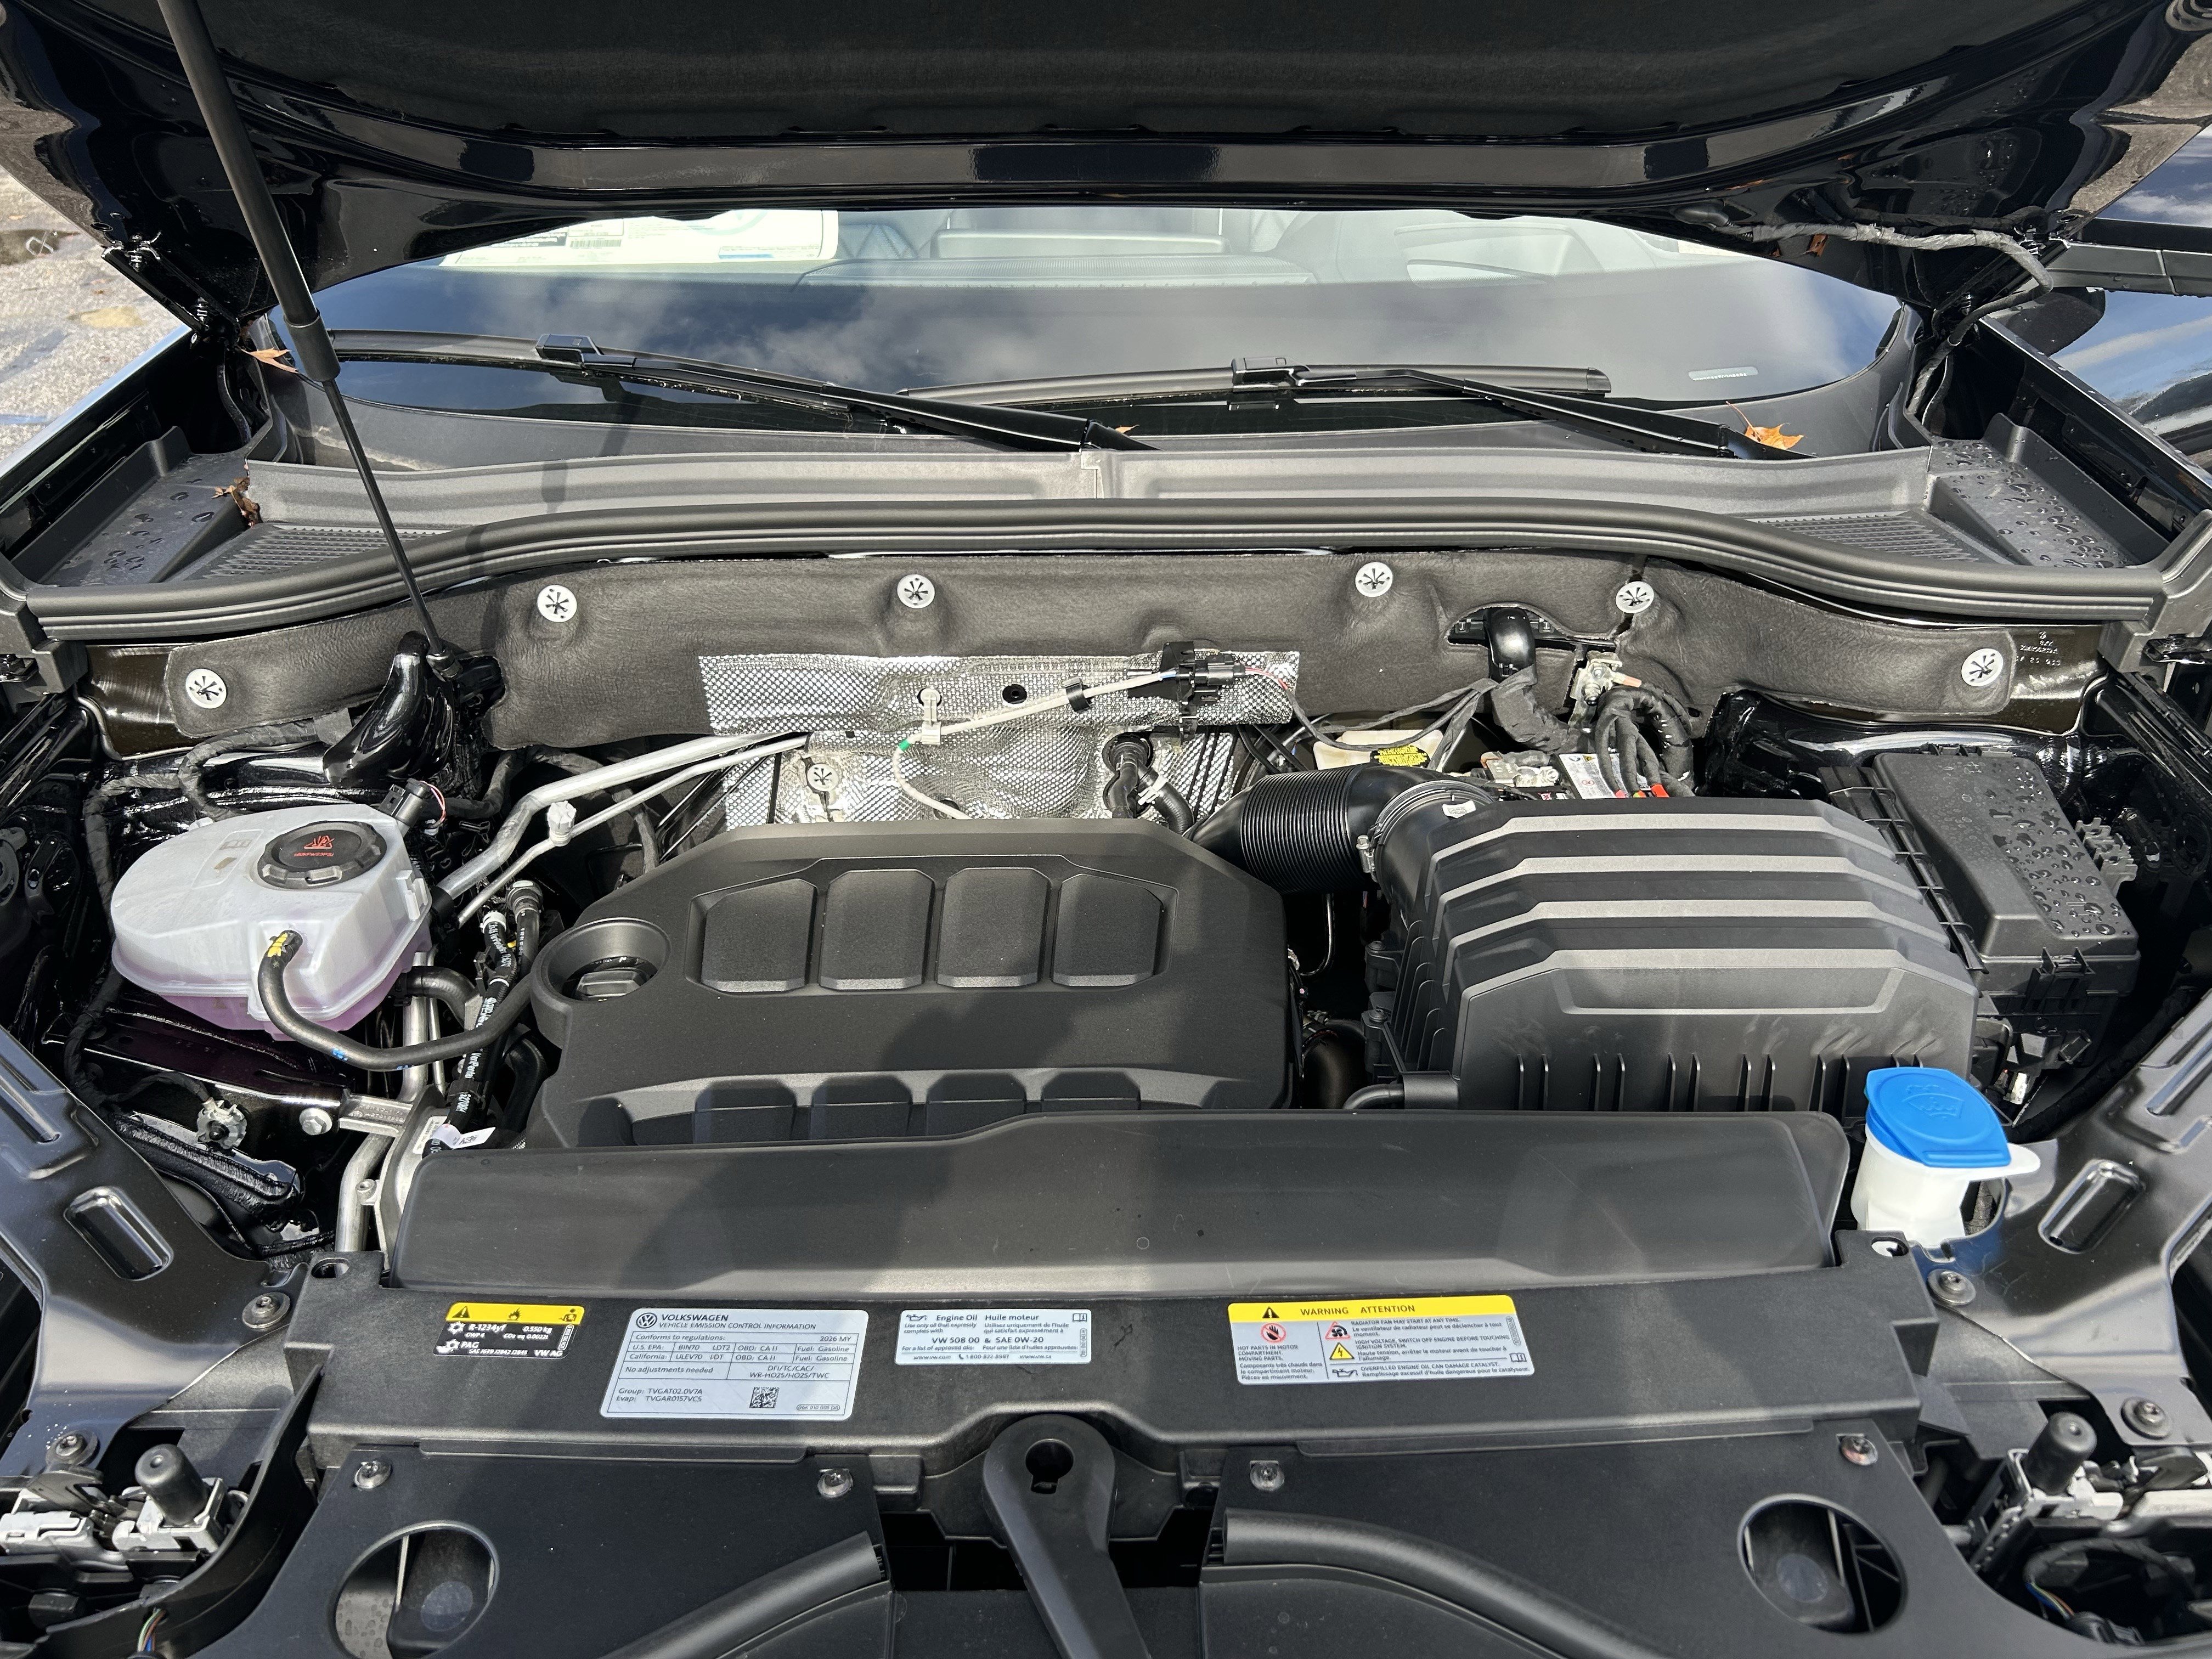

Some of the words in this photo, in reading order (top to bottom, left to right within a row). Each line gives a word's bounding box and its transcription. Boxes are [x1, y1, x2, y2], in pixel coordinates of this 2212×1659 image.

[1300, 1307, 1349, 1316] WARNING
[1360, 1305, 1415, 1313] ATTENTION
[936, 1314, 964, 1322] Engine
[468, 1323, 507, 1333] R-1234yf
[543, 1326, 553, 1334] kg
